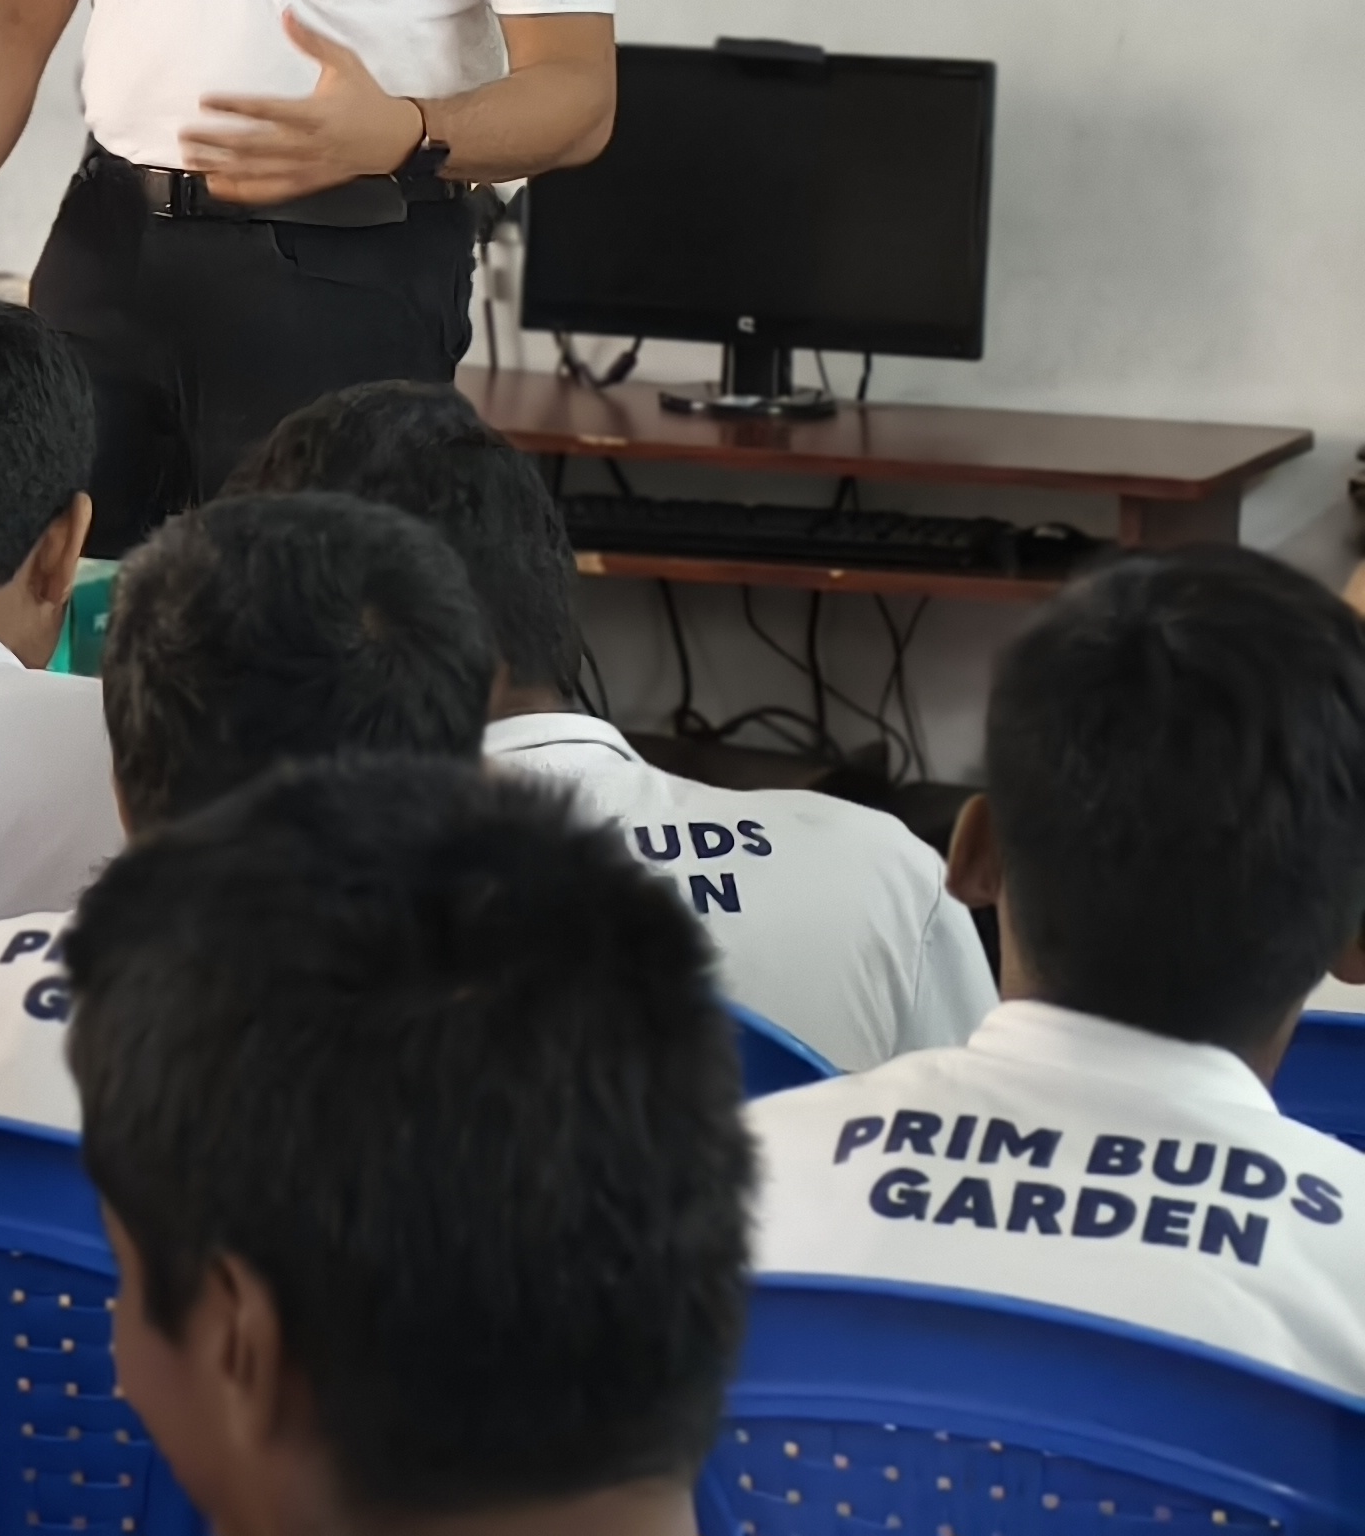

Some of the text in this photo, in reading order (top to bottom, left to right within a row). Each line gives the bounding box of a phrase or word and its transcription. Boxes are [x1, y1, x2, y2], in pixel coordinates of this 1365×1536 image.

[633, 819, 773, 861] UDS
[833, 1109, 1345, 1225] PRIM BUDS
[868, 1166, 1269, 1267] GARDEN
